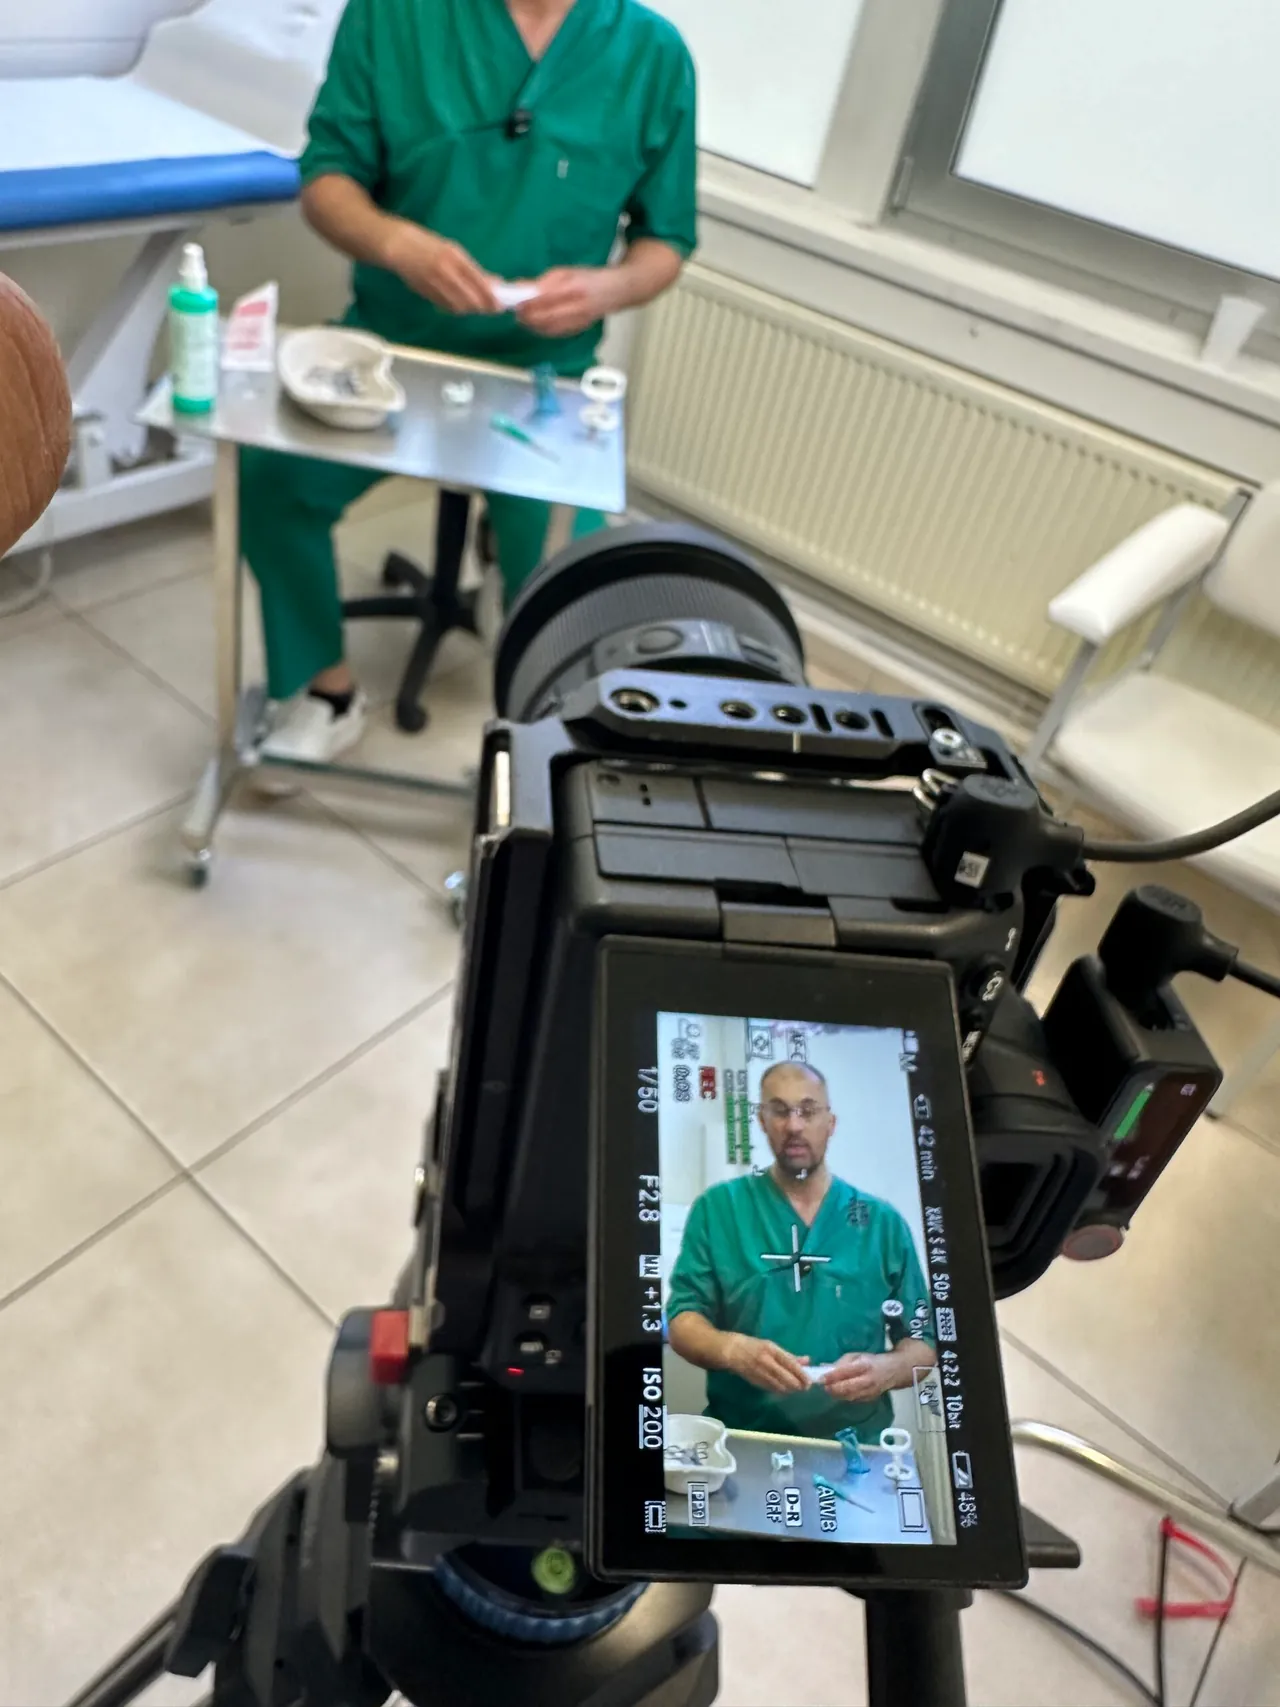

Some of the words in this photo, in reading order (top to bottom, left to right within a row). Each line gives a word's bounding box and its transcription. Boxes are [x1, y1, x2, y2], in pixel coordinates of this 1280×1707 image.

[638, 1067, 658, 1113] 1/50
[918, 1124, 936, 1147] 42
[920, 1150, 938, 1180] min
[638, 1174, 661, 1222] F2.8
[642, 1287, 661, 1332] +1.3
[642, 1367, 662, 1401] ISO
[941, 1350, 961, 1387] 4:2:2
[643, 1406, 663, 1448] 200
[786, 1493, 800, 1521] D-R
[816, 1485, 838, 1532] AWB
[957, 1492, 978, 1528] 48%
